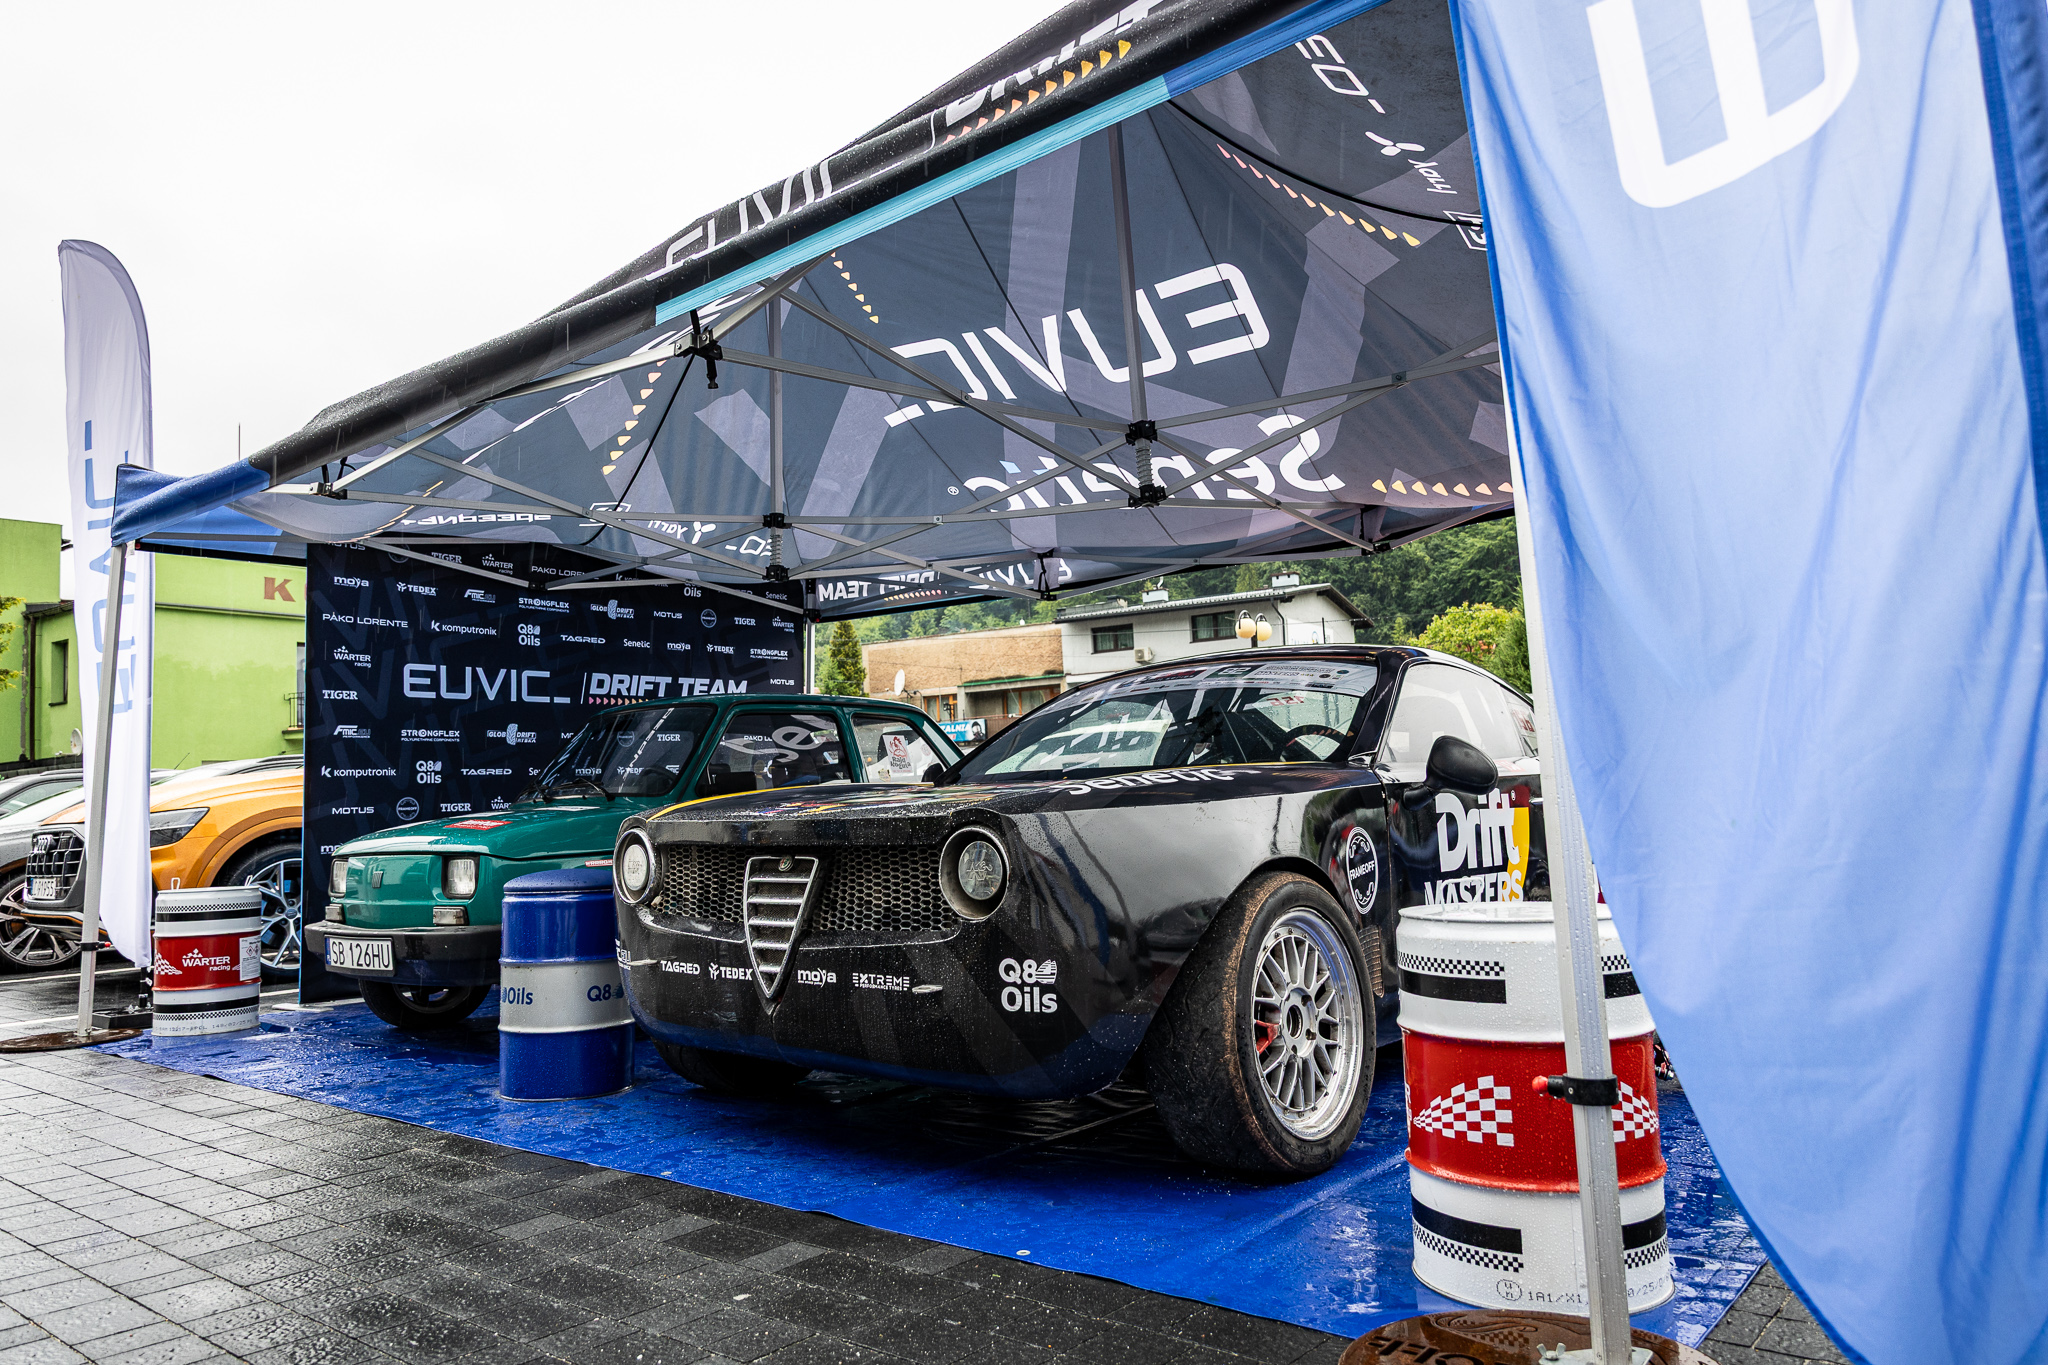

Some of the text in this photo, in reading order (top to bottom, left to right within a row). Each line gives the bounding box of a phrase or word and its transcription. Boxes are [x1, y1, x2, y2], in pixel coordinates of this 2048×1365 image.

[482, 560, 514, 570] WARTER
[531, 565, 557, 575] PAKO
[334, 576, 370, 590] moya
[407, 584, 438, 595] TEDEX
[684, 586, 702, 598] Oils
[766, 591, 788, 601] Senetic
[518, 597, 570, 610] STRONGFLEX
[322, 612, 409, 628] PAKO LORENTE
[653, 610, 683, 619] MOTUS
[733, 616, 756, 626] TIGER
[772, 621, 795, 629] WARTER
[442, 623, 497, 636] komputronik
[518, 634, 541, 647] Oils
[560, 634, 606, 644] TAGRED
[623, 638, 651, 648] Senetic
[667, 641, 691, 651] moya
[713, 645, 734, 653] TEDEX
[333, 652, 372, 662] WARTER
[750, 648, 788, 657] STRONGFLEX
[589, 672, 673, 697] DRIFT
[678, 676, 748, 696] TEAM
[770, 678, 795, 686] MOTUS
[322, 689, 358, 700] TIGER
[401, 728, 460, 738] STRONGFLEX
[657, 733, 681, 742] TIGER
[334, 767, 397, 779] komputronik
[417, 771, 442, 784] Oils
[461, 768, 512, 776] TAGRED
[332, 806, 375, 815] MOTUS
[440, 802, 472, 812] TIGER
[1435, 787, 1520, 873] Drift
[1349, 860, 1375, 881] FRAMEOFF
[1424, 869, 1524, 905] MASTERS
[331, 940, 390, 969] SB 126HU
[182, 955, 231, 967] WARTER
[660, 959, 701, 975] TAGRED
[209, 964, 231, 972] racing
[720, 966, 753, 981] TEDEX
[999, 957, 1038, 985] Q8
[797, 967, 837, 988] moya
[852, 972, 910, 990] EXTREME
[507, 986, 534, 1006] Oils
[587, 983, 612, 1002] Q8
[1001, 986, 1058, 1013] Oils
